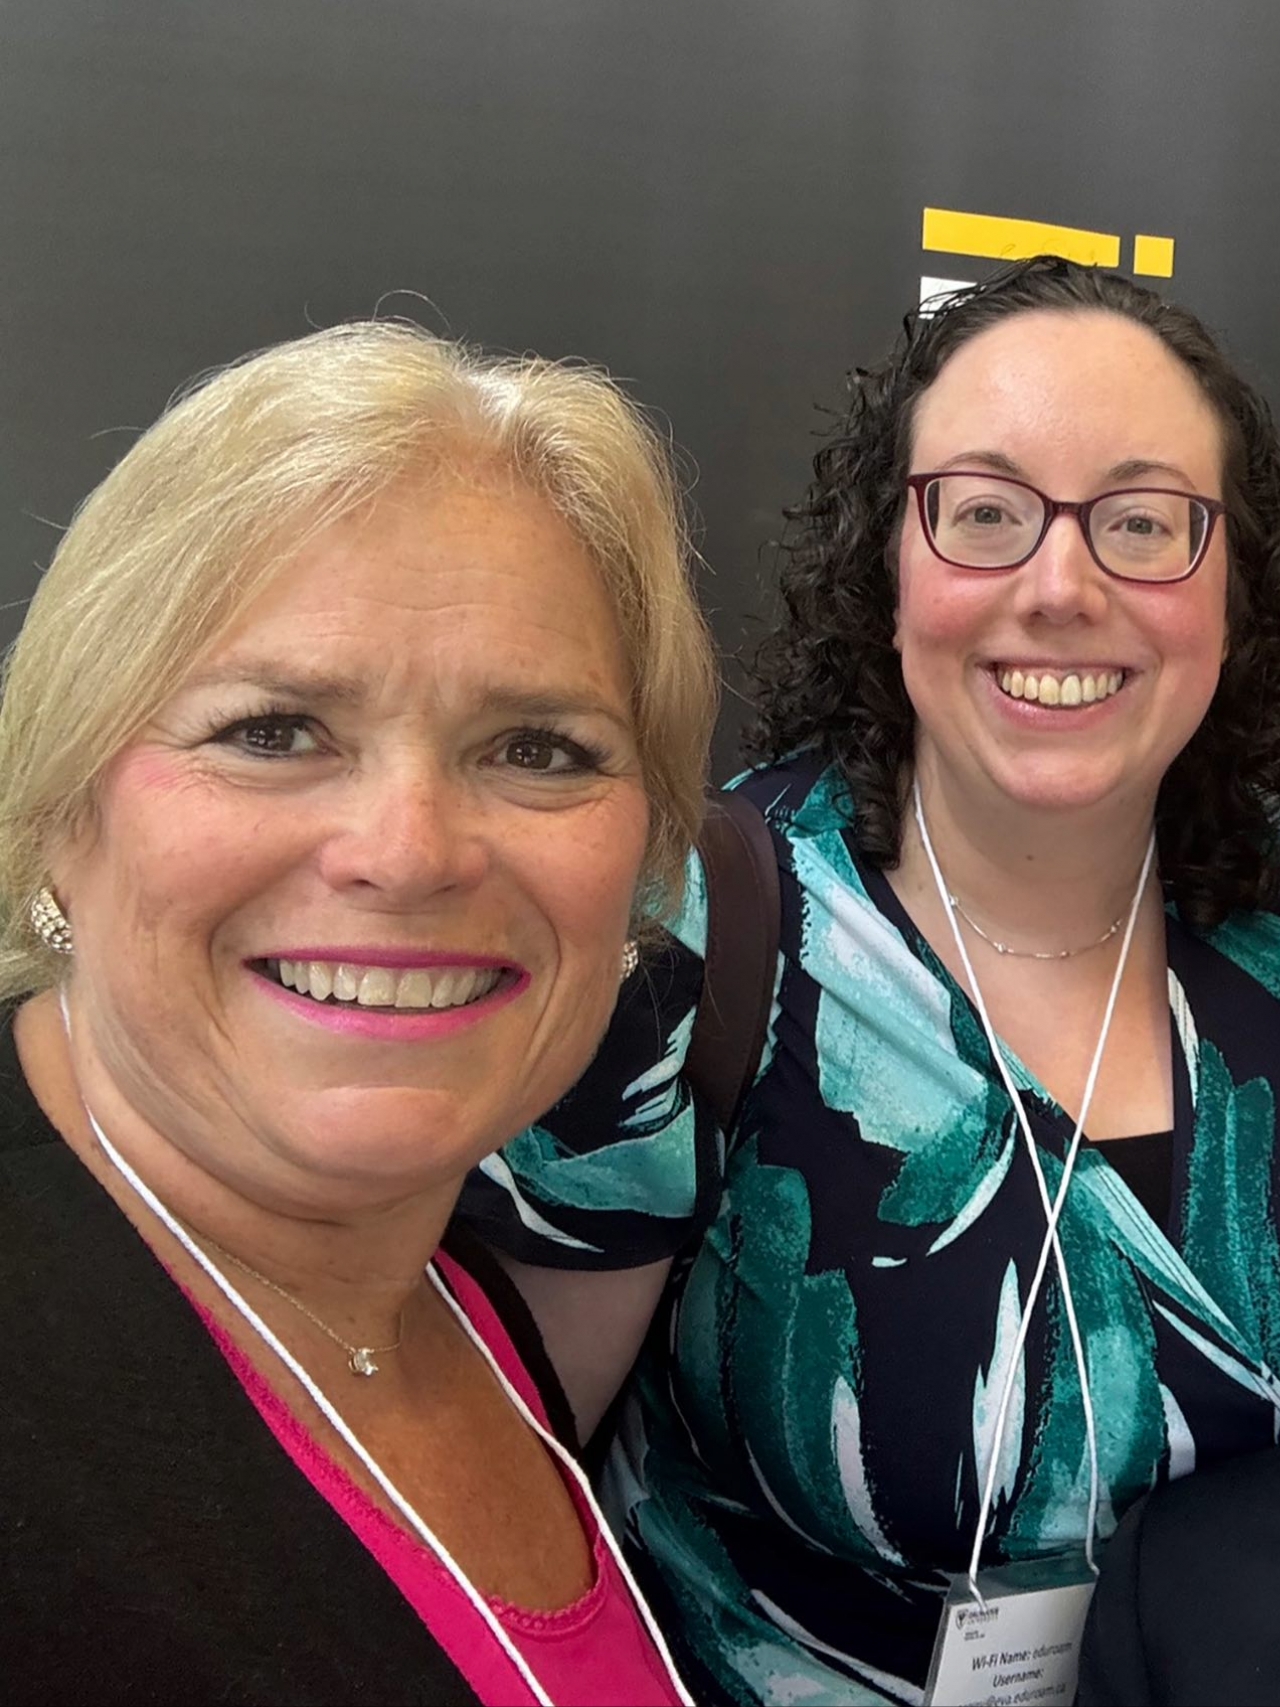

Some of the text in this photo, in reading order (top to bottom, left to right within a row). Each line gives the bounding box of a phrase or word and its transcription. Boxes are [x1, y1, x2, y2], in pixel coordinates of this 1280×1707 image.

[972, 1653, 999, 1671] Wi-Fi
[1000, 1651, 1031, 1665] Name:
[993, 1668, 1044, 1687] Username:
